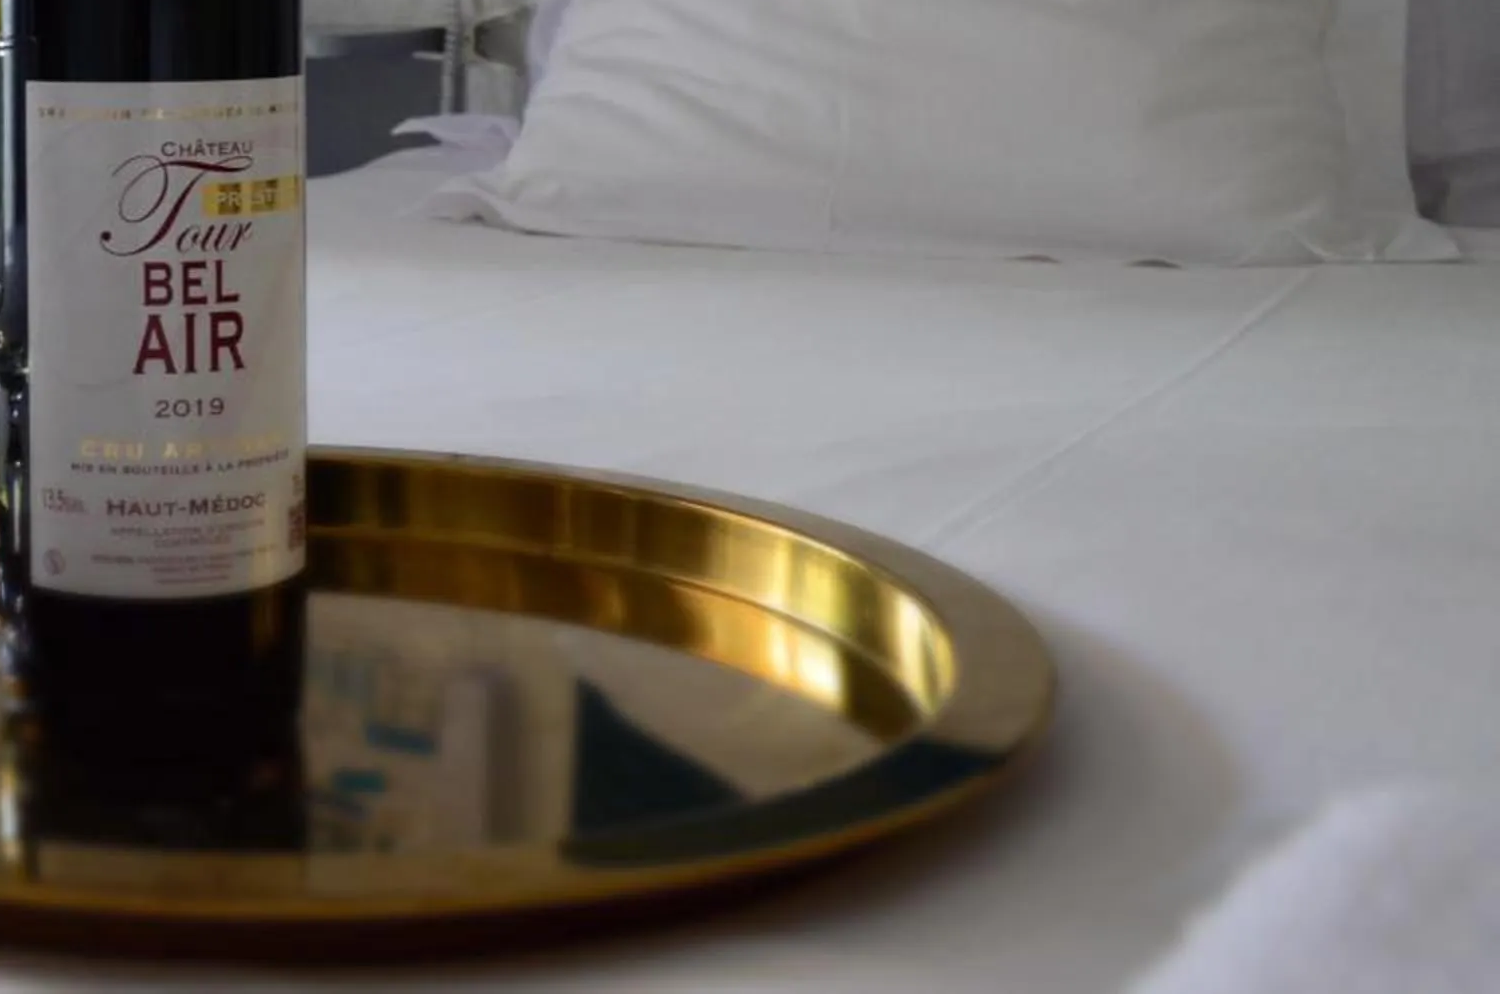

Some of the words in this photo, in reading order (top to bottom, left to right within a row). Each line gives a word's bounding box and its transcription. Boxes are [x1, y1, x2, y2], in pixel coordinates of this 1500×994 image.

[160, 138, 253, 157] CHÂTEAU
[100, 155, 253, 257] Tour
[142, 259, 241, 307] BEL
[132, 310, 246, 375] AIR
[154, 397, 226, 419] 2019
[105, 492, 267, 518] HAUT-MÉDOC
